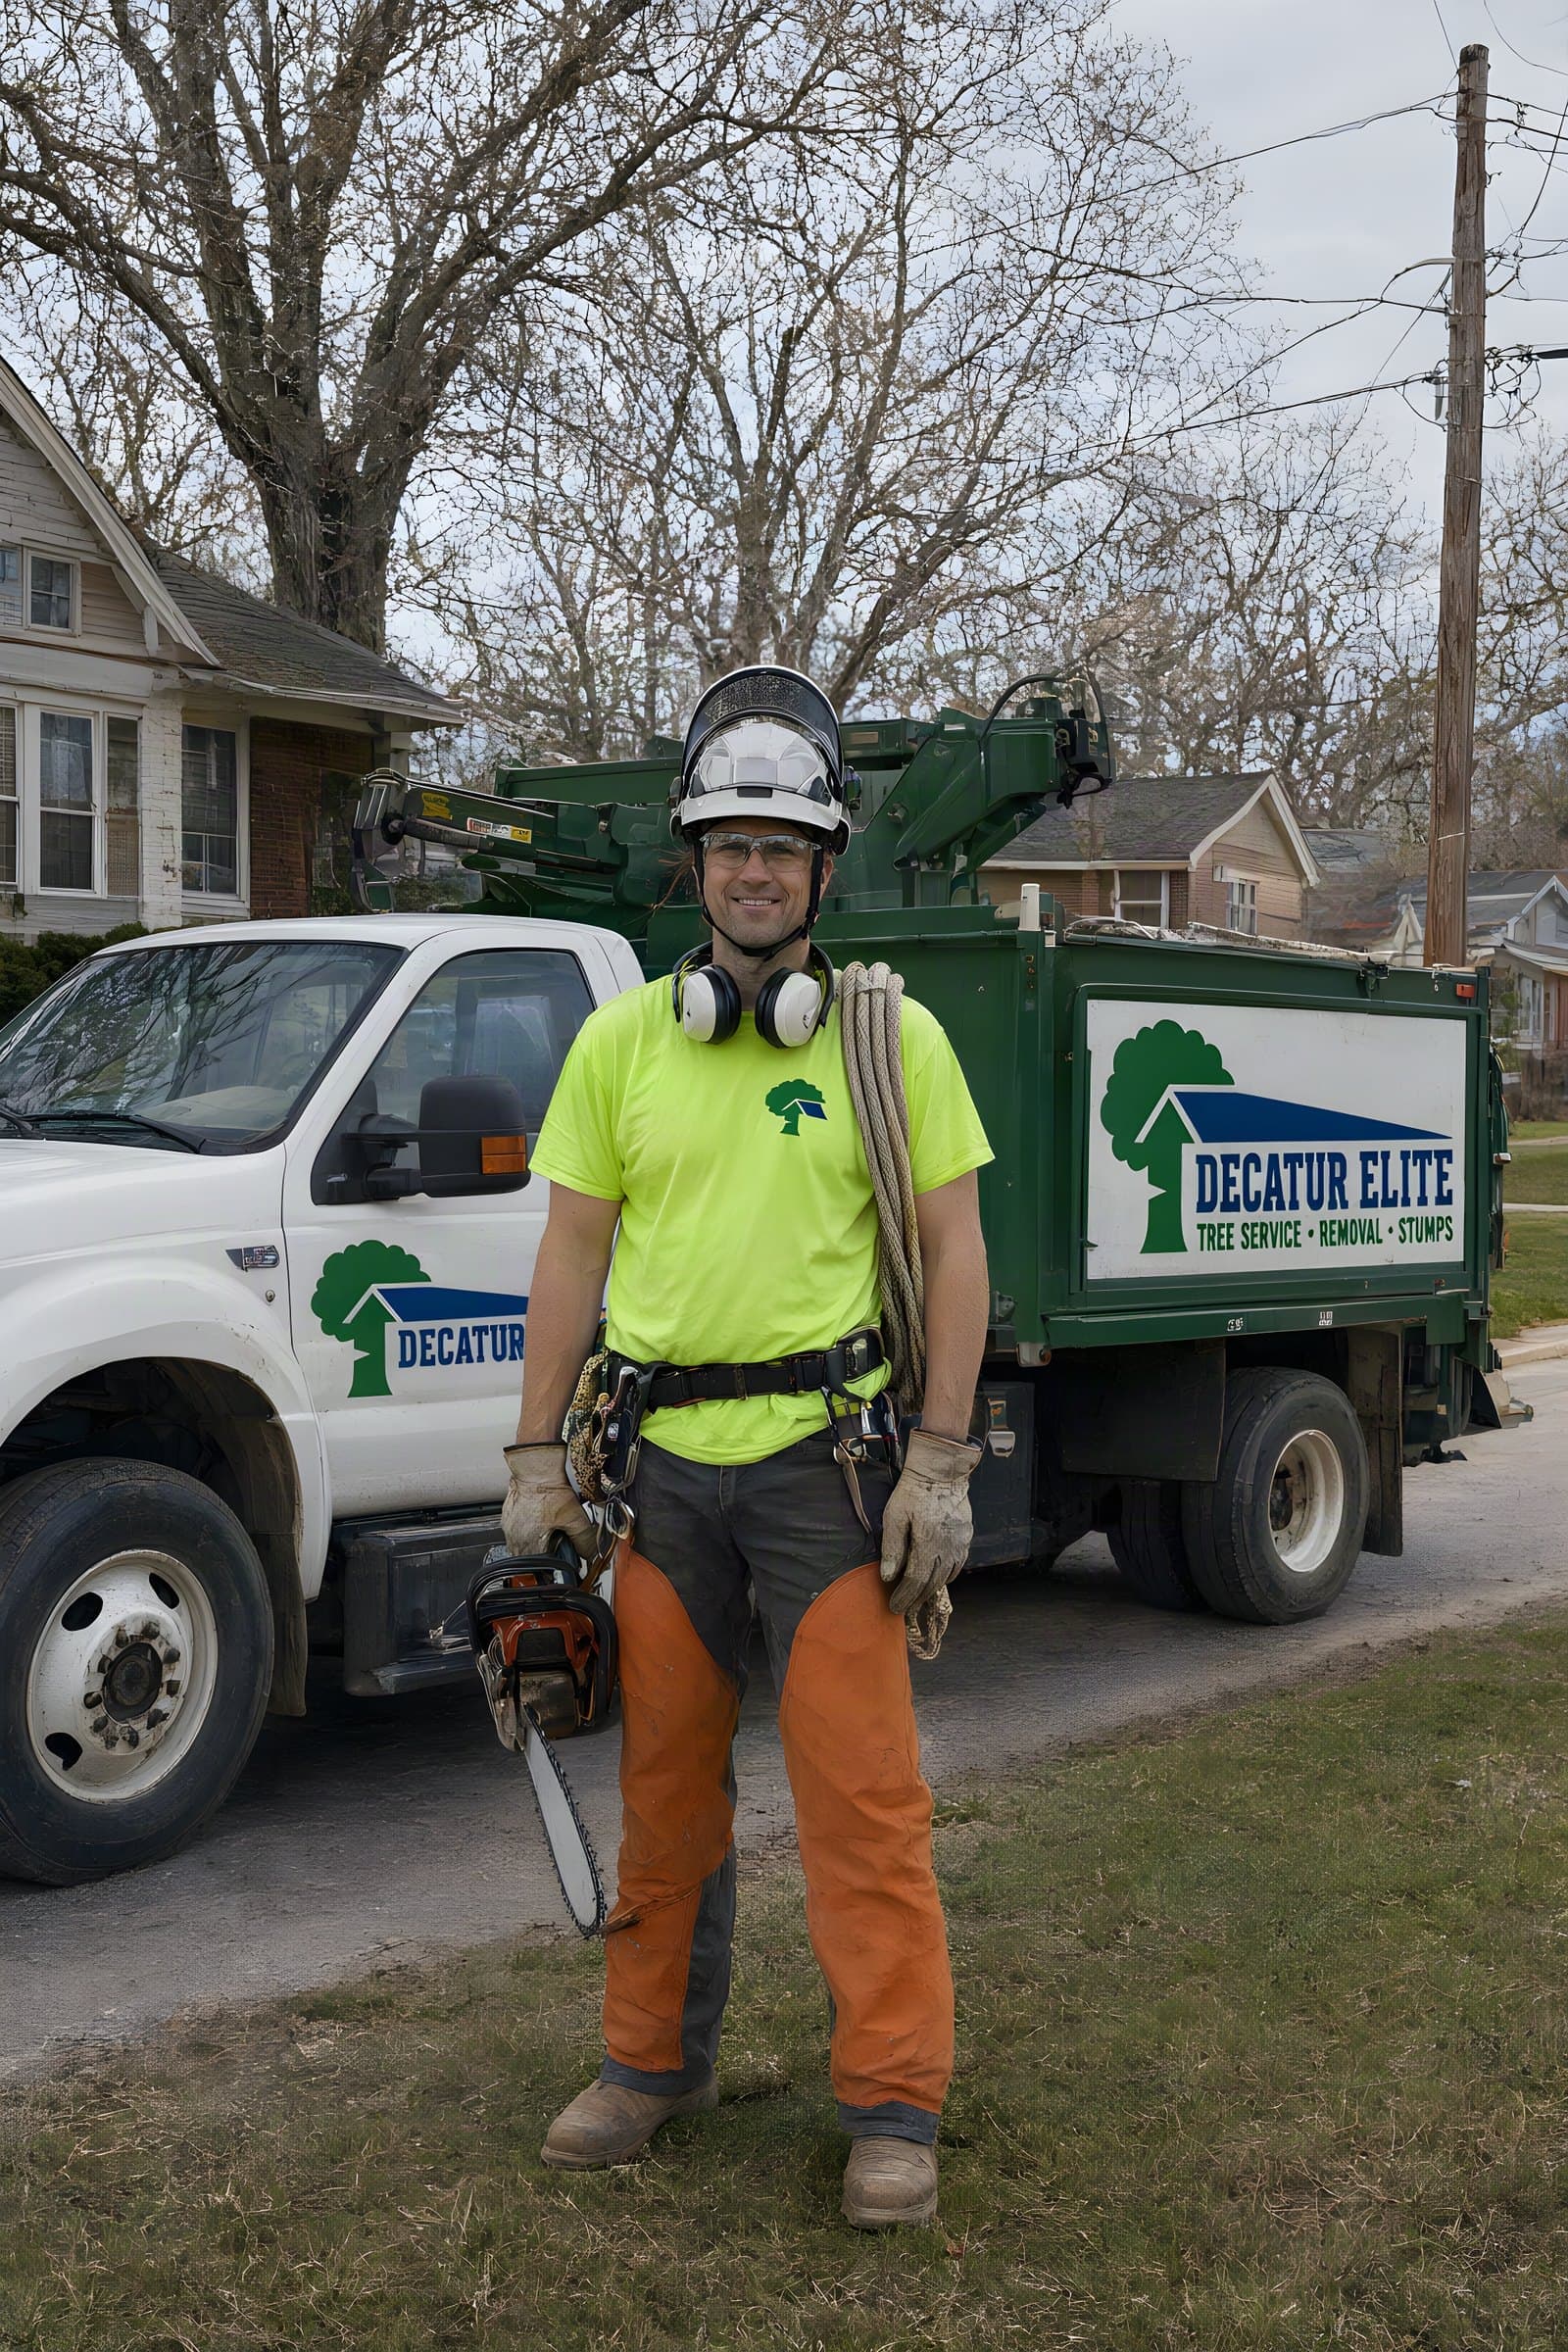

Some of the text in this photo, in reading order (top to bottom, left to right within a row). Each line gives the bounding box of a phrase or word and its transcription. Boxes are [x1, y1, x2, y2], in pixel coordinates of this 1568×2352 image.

[1196, 1150, 1452, 1213] DECATUR ELITE
[1196, 1215, 1453, 1252] TREE SERVICE REMOVAL STUMPS
[398, 1323, 525, 1368] DECATUR
